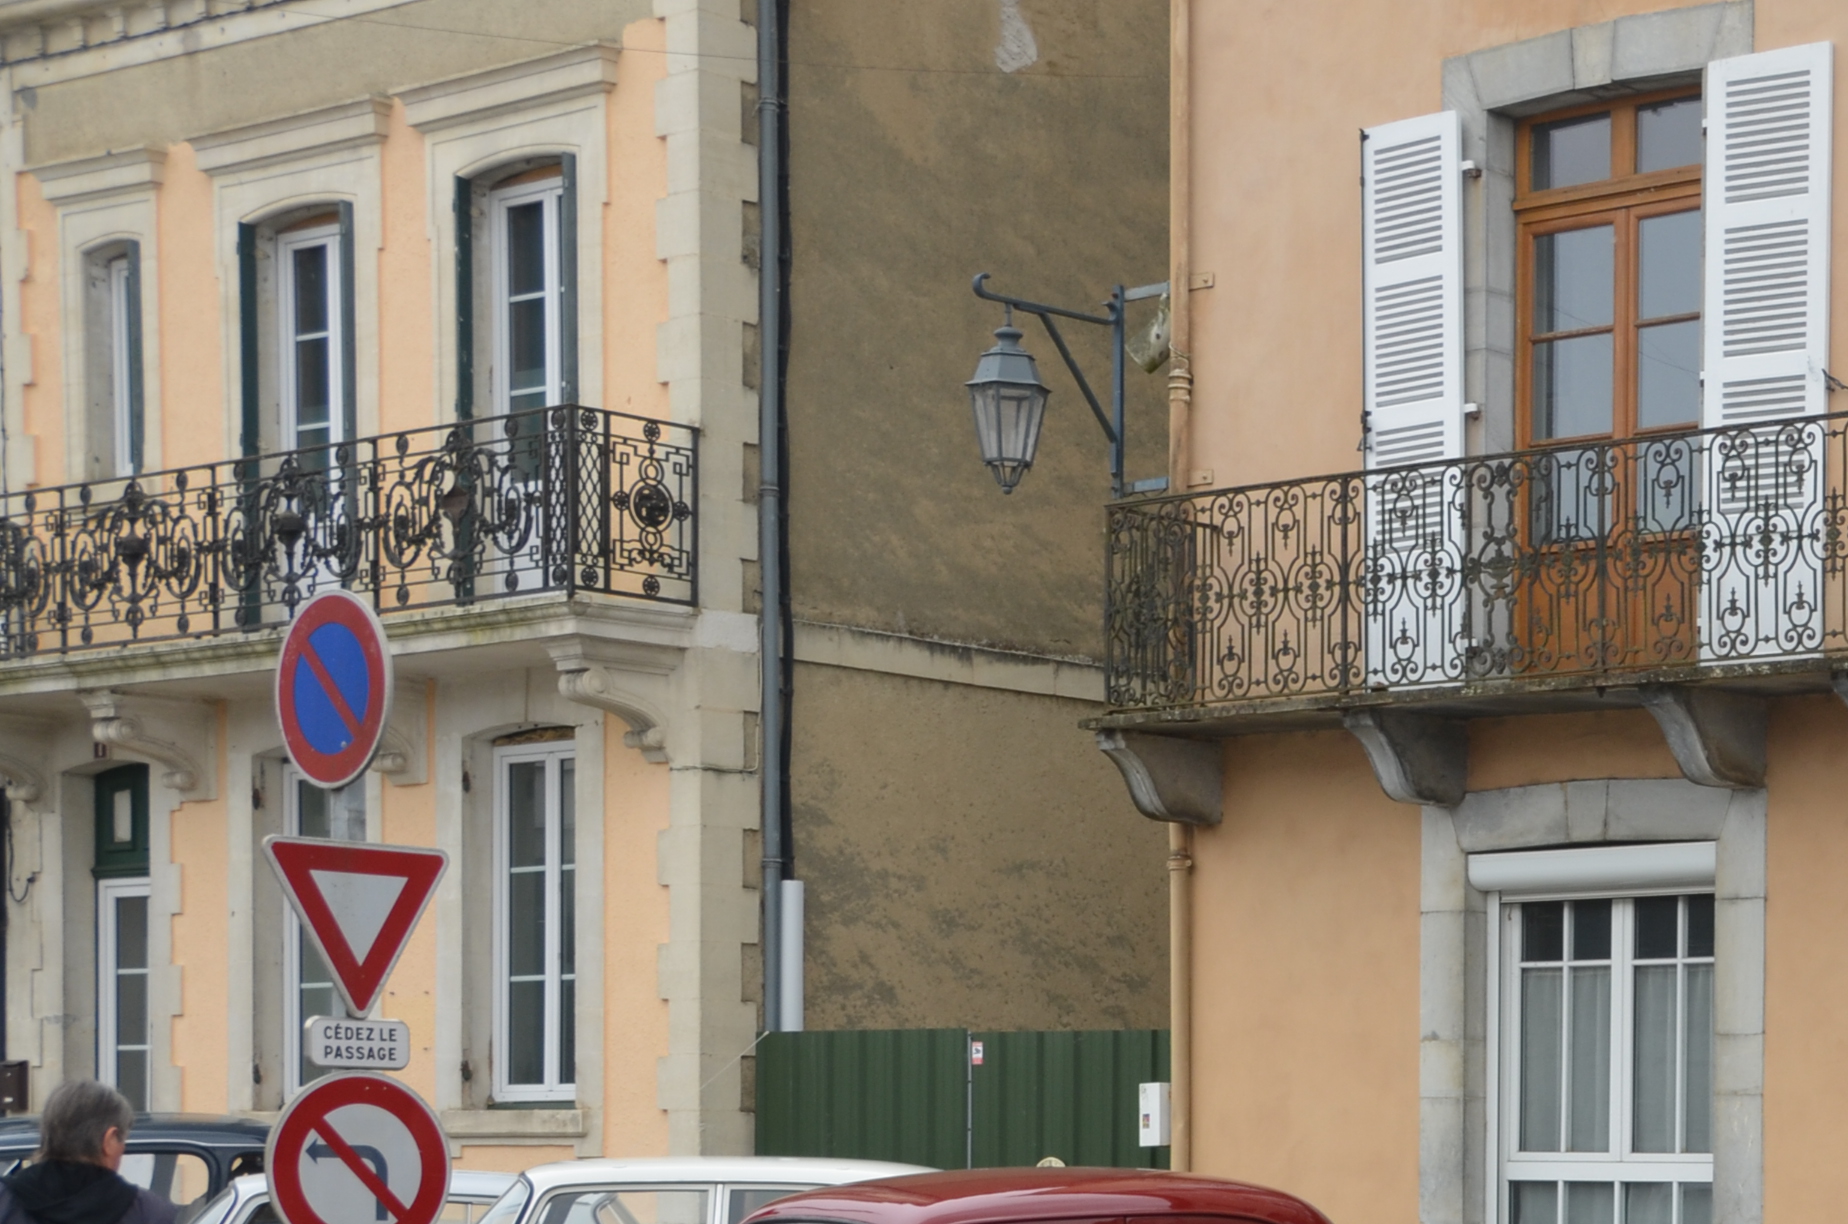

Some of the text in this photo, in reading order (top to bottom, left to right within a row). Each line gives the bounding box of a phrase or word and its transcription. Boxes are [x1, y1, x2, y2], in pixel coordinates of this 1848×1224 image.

[323, 1023, 398, 1042] CÉDEZ LE
[323, 1045, 398, 1062] PASSAGE
